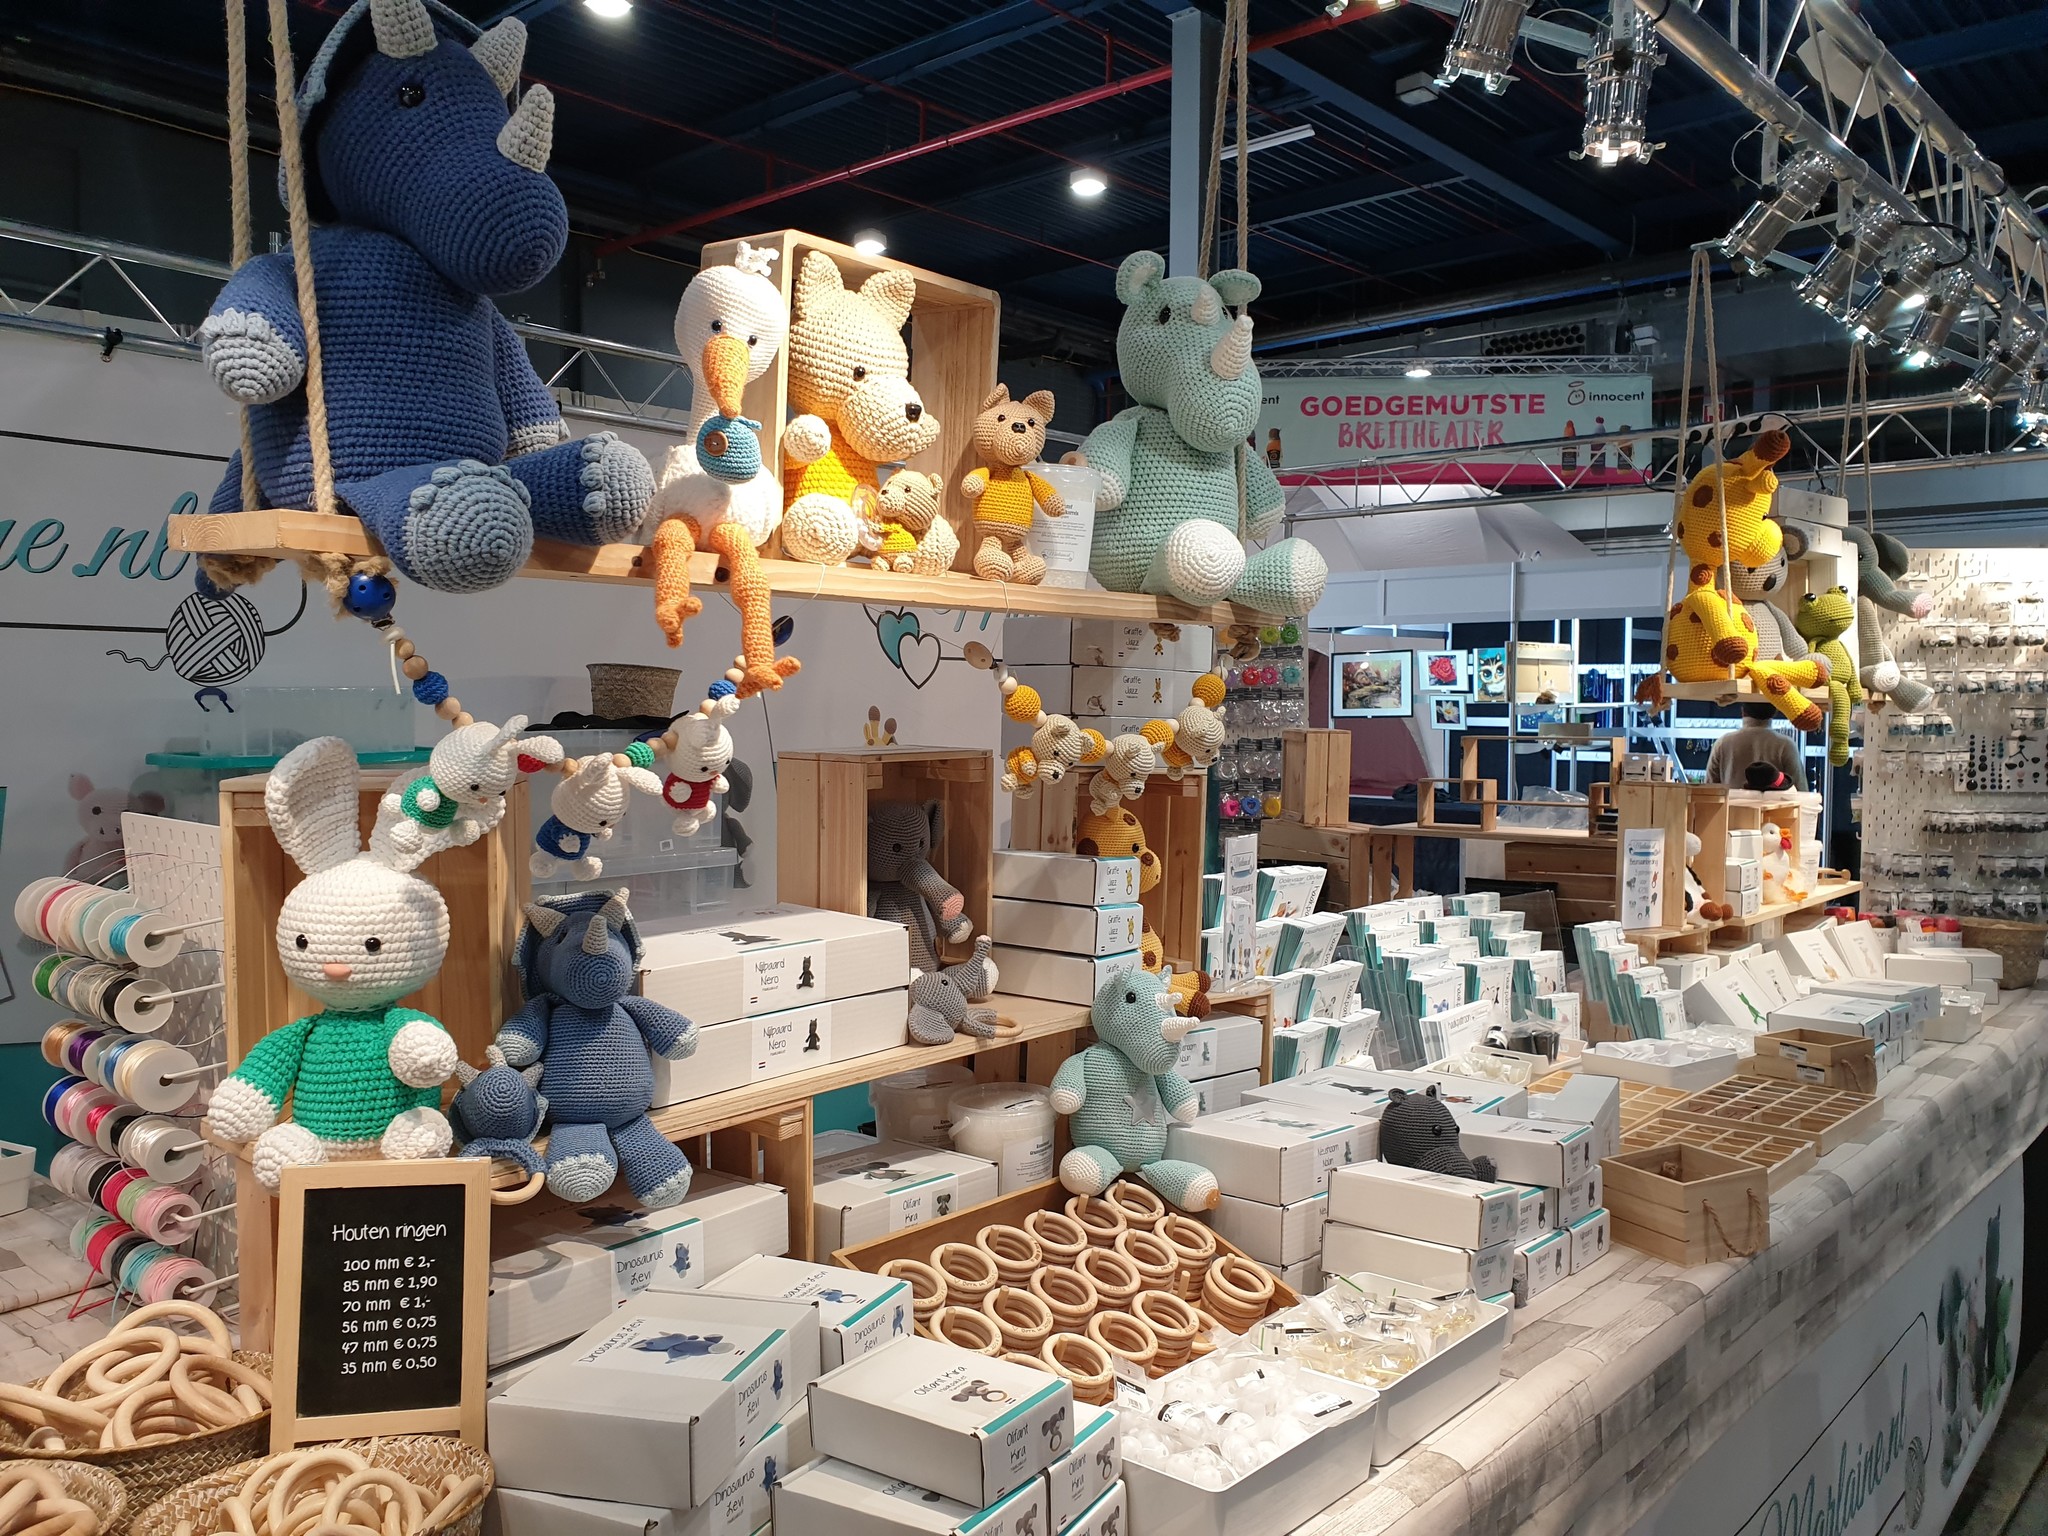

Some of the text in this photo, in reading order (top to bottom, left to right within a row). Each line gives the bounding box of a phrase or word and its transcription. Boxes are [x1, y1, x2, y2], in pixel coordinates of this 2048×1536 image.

[1589, 391, 1645, 401] innocent
[1300, 394, 1545, 417] GOEDGEMUTSTE
[1125, 638, 1140, 646] Jazz
[1124, 687, 1139, 695] Jazz
[760, 975, 780, 986] Nero
[768, 1039, 787, 1051] Nero
[331, 1222, 447, 1242] Houten ringen
[343, 1255, 436, 1272] 100 mm € 2,-
[343, 1275, 438, 1293] 85 mm € 1,90
[342, 1300, 361, 1313] 70
[365, 1298, 391, 1312] mm
[400, 1297, 411, 1309] €
[341, 1315, 437, 1334] 56 mm € 0,75
[341, 1335, 438, 1355] 47 mm € 0,75
[340, 1356, 437, 1375] 35 mm € 0,50
